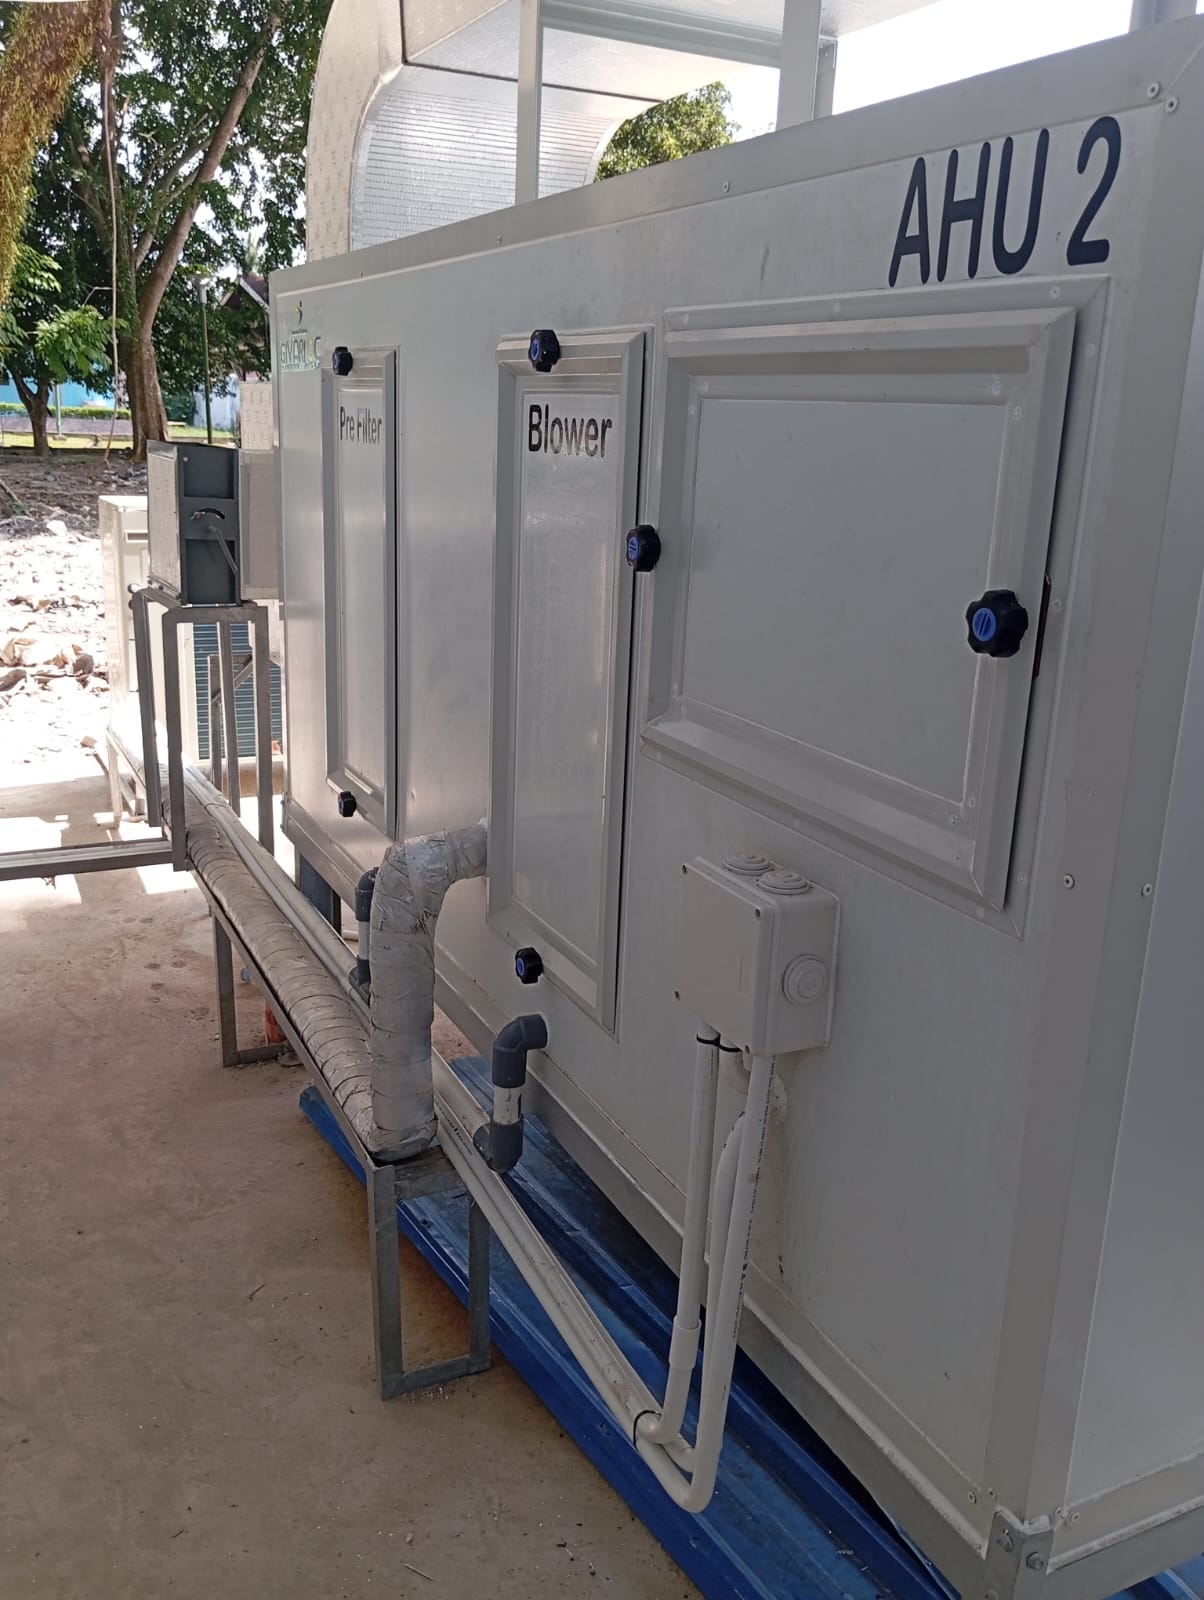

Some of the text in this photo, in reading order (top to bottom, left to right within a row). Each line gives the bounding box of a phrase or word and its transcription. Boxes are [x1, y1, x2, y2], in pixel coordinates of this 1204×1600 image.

[888, 116, 1122, 288] AHU 2
[340, 406, 382, 446] Pre Filter
[528, 404, 613, 458] Blower
